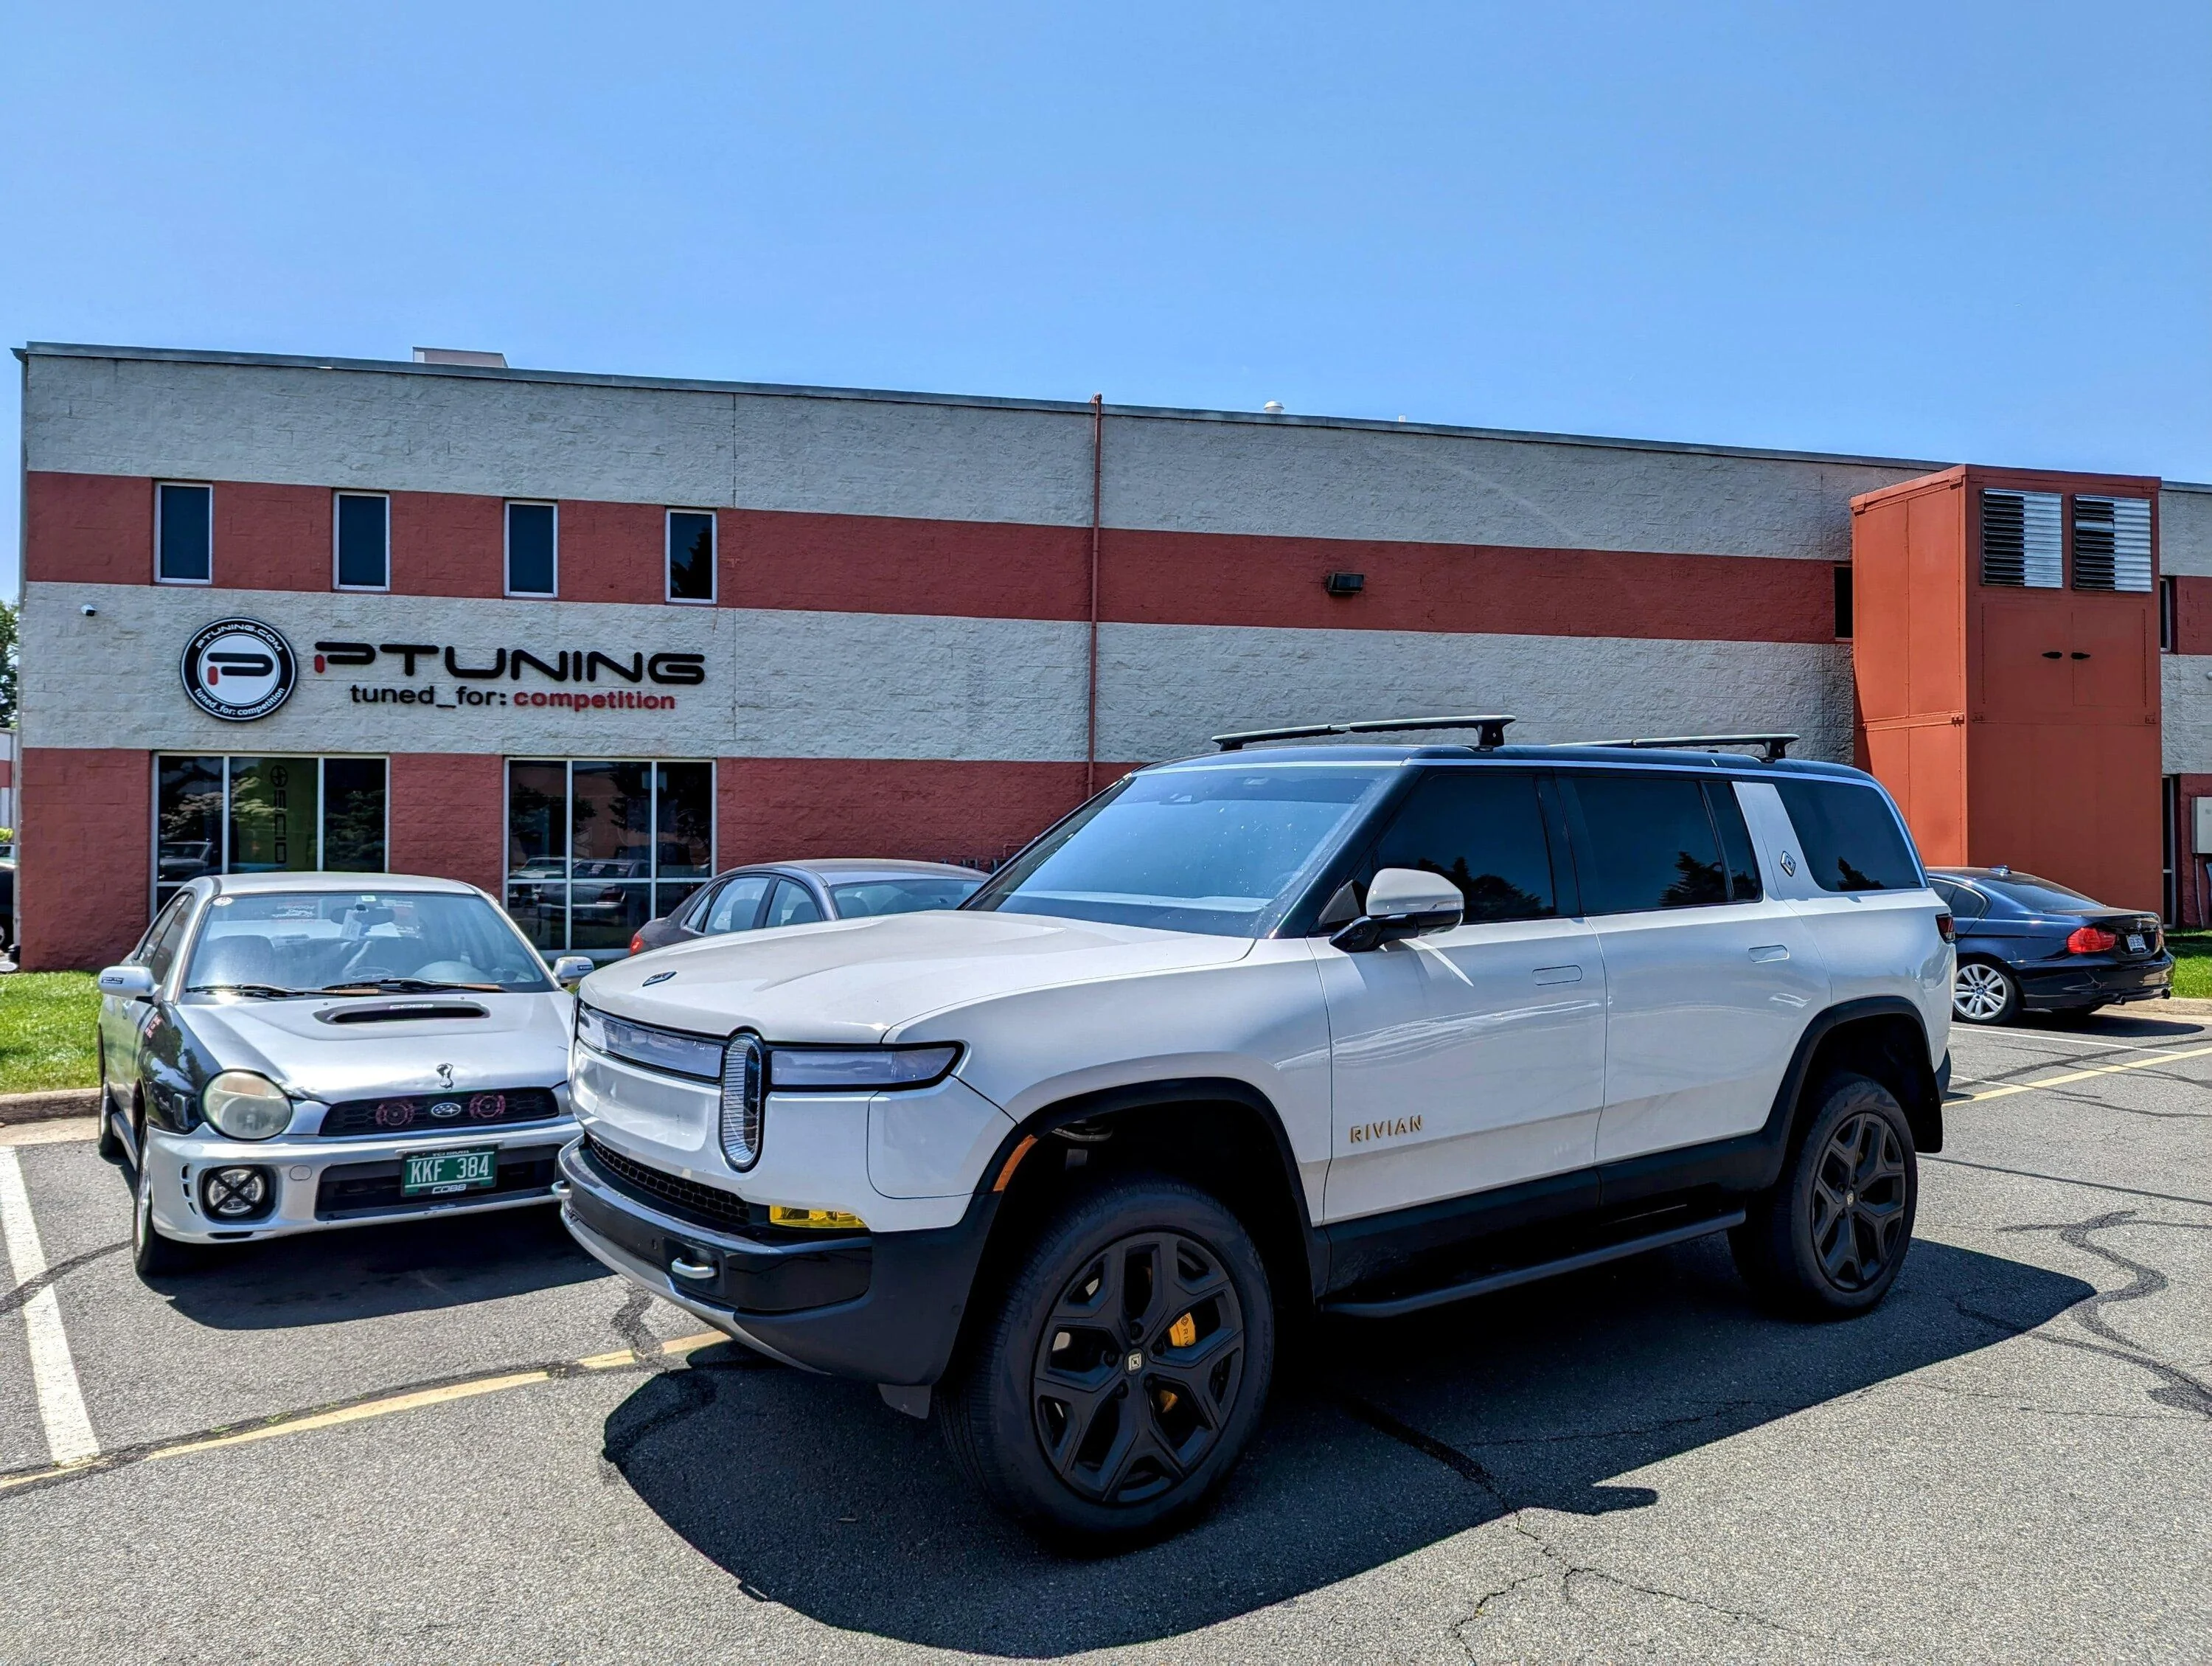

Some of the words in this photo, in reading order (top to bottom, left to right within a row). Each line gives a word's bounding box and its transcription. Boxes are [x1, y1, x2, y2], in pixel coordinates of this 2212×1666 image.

[195, 624, 283, 652] PTUNING.COM
[314, 641, 705, 684] PTUNING
[195, 687, 236, 715] tuned_for:
[237, 687, 285, 715] competition
[350, 684, 507, 708] tuned_for:
[513, 690, 676, 712] competition
[1350, 1114, 1422, 1144] RIVIAN
[411, 1159, 445, 1184] KKF
[456, 1154, 489, 1179] 384
[432, 1183, 467, 1194] COBB
